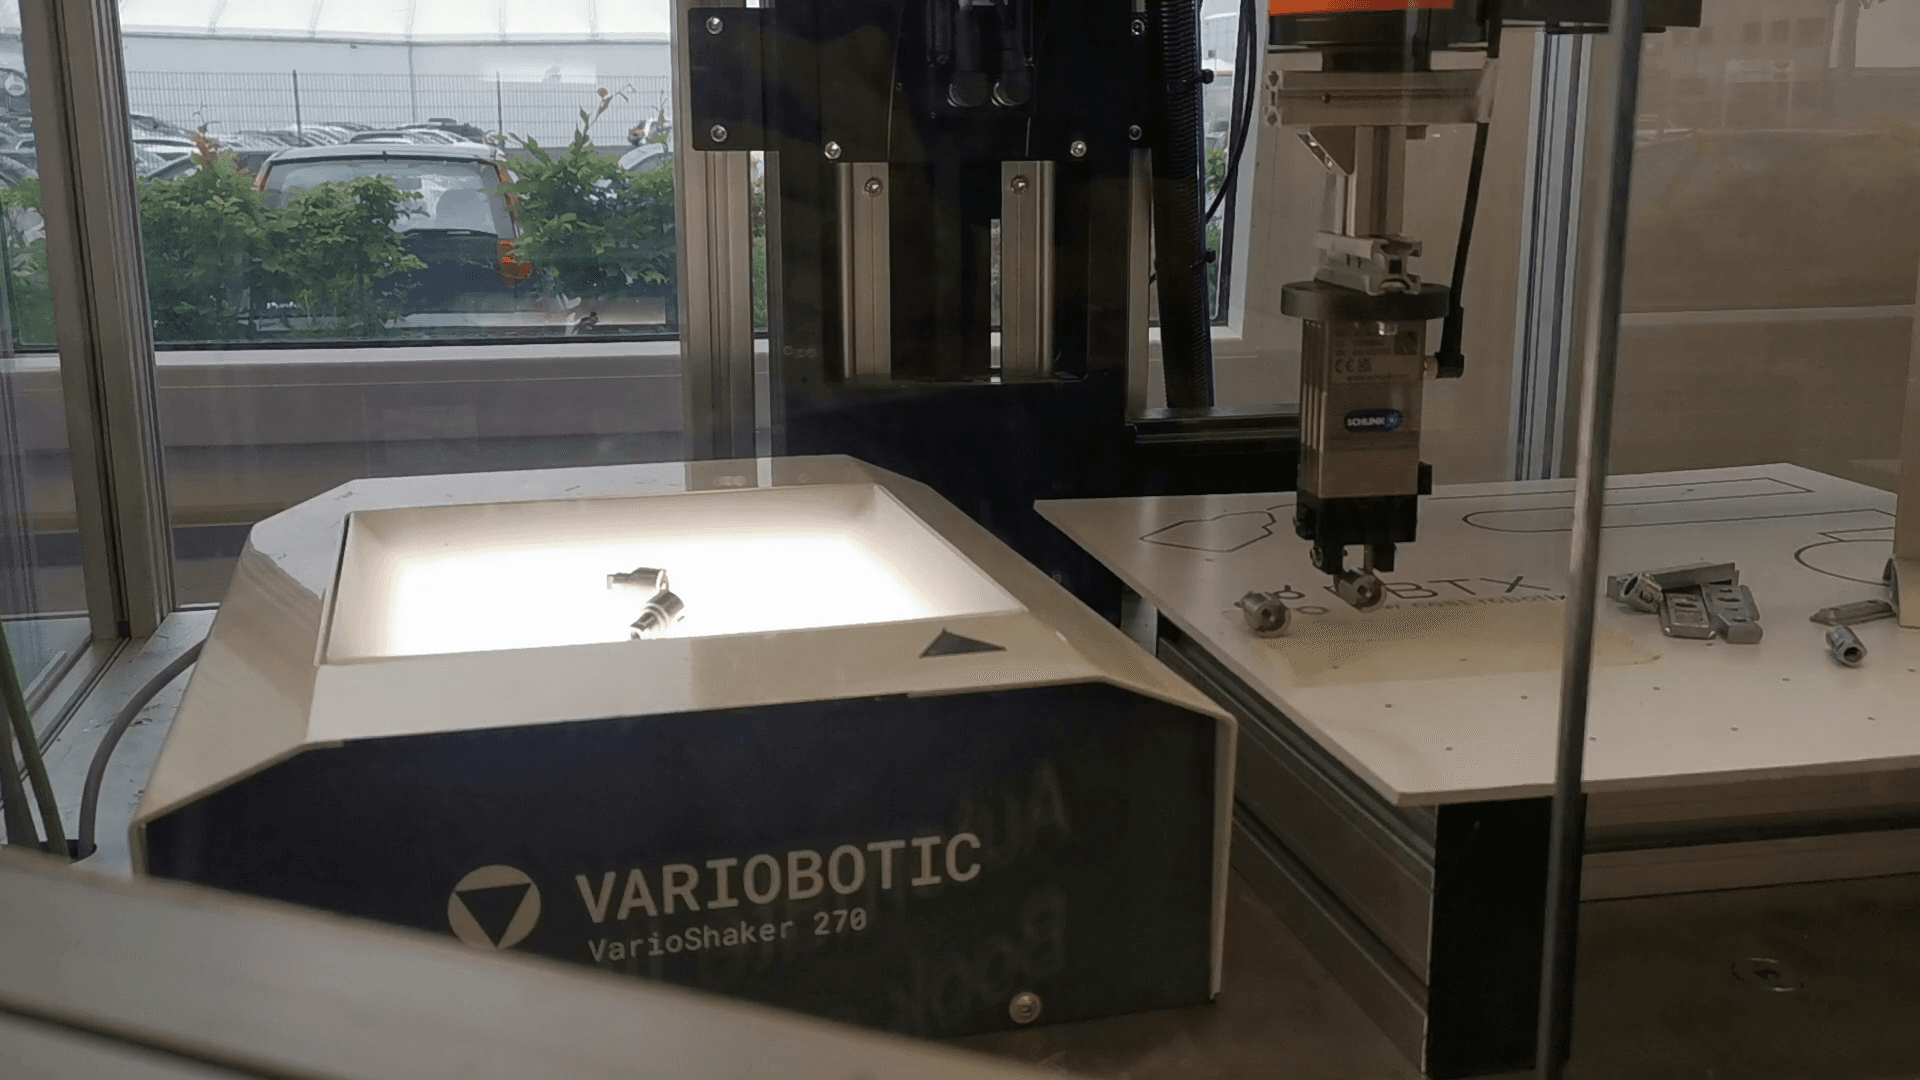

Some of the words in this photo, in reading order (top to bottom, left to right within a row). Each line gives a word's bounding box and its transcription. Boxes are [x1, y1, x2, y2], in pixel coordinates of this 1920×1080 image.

[1323, 576, 1552, 603] BTX
[575, 832, 982, 924] VARIOBOTIC
[587, 917, 794, 963] VarioShaker
[813, 907, 868, 937] 270
